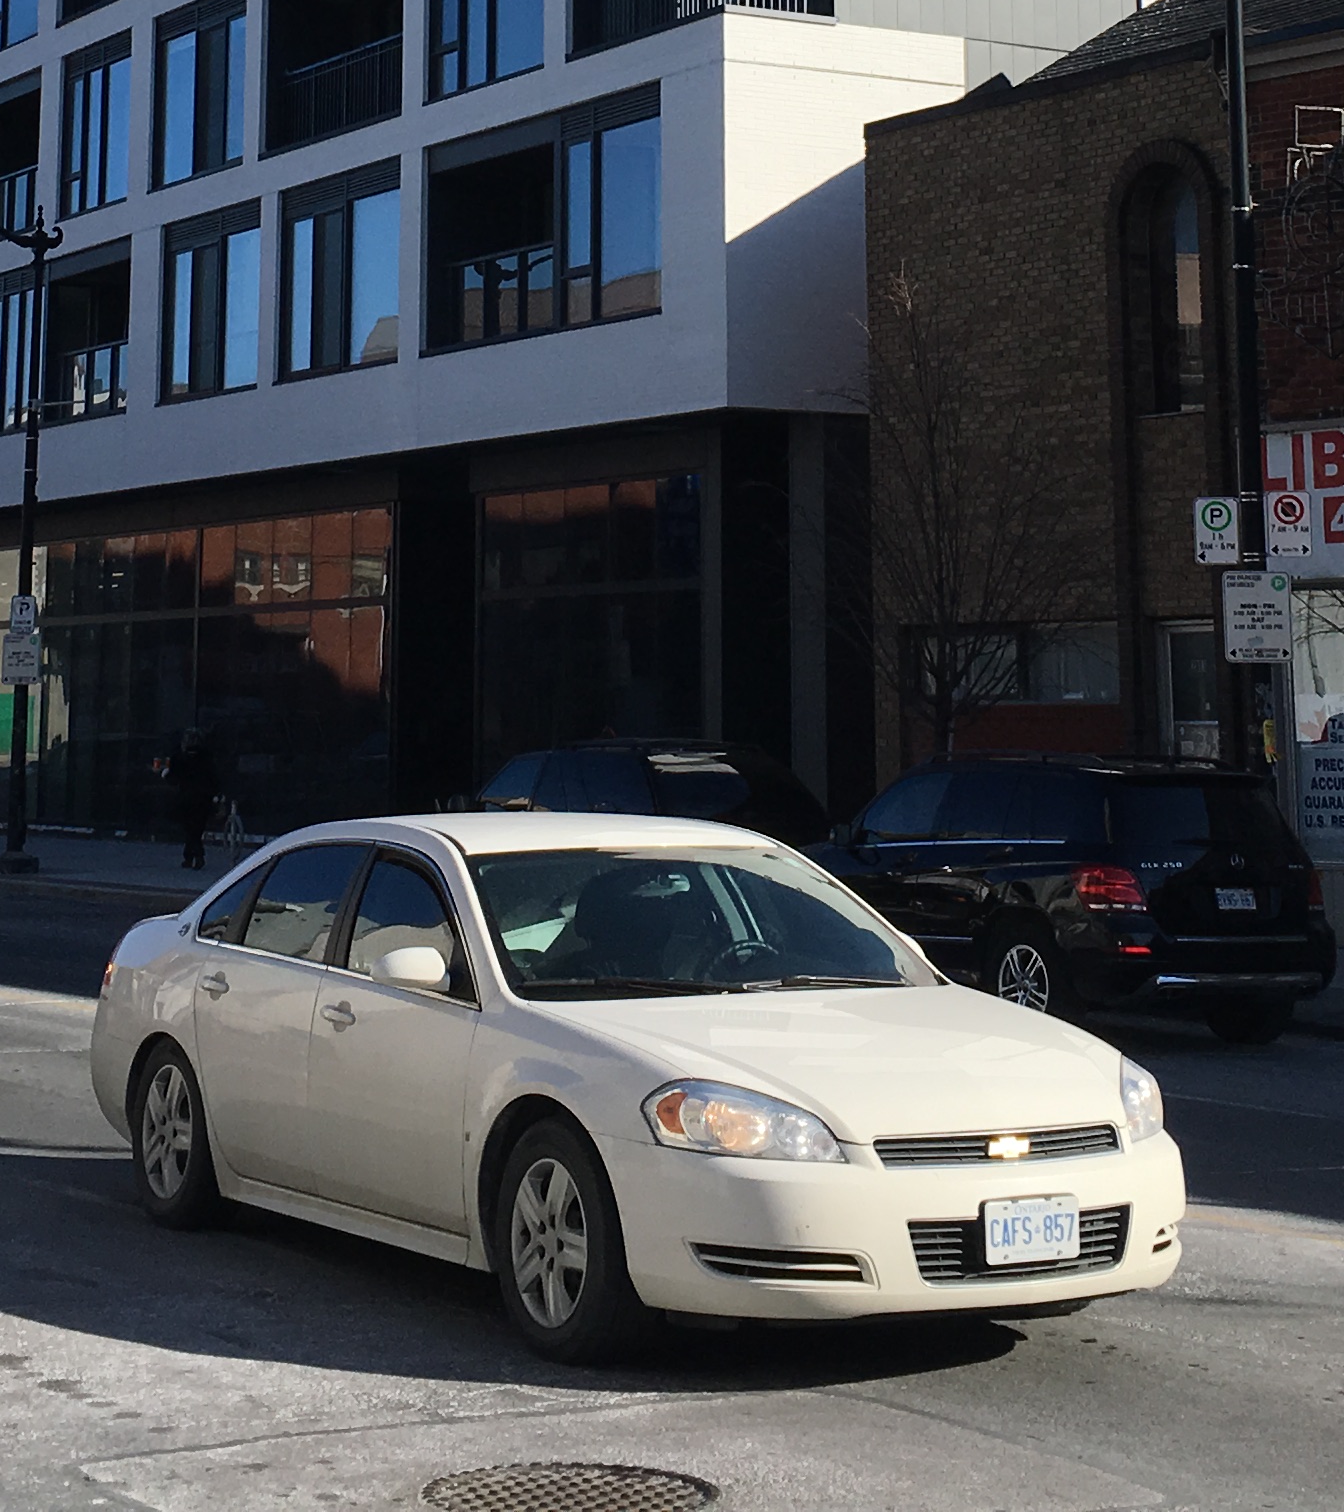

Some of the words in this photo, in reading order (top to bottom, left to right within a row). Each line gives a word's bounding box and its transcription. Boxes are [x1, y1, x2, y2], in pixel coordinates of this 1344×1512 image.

[1210, 508, 1223, 524] P
[20, 602, 30, 615] P
[1014, 1204, 1051, 1215] ONTARIO
[990, 1216, 1032, 1248] CAFS
[1044, 1213, 1075, 1243] 857
